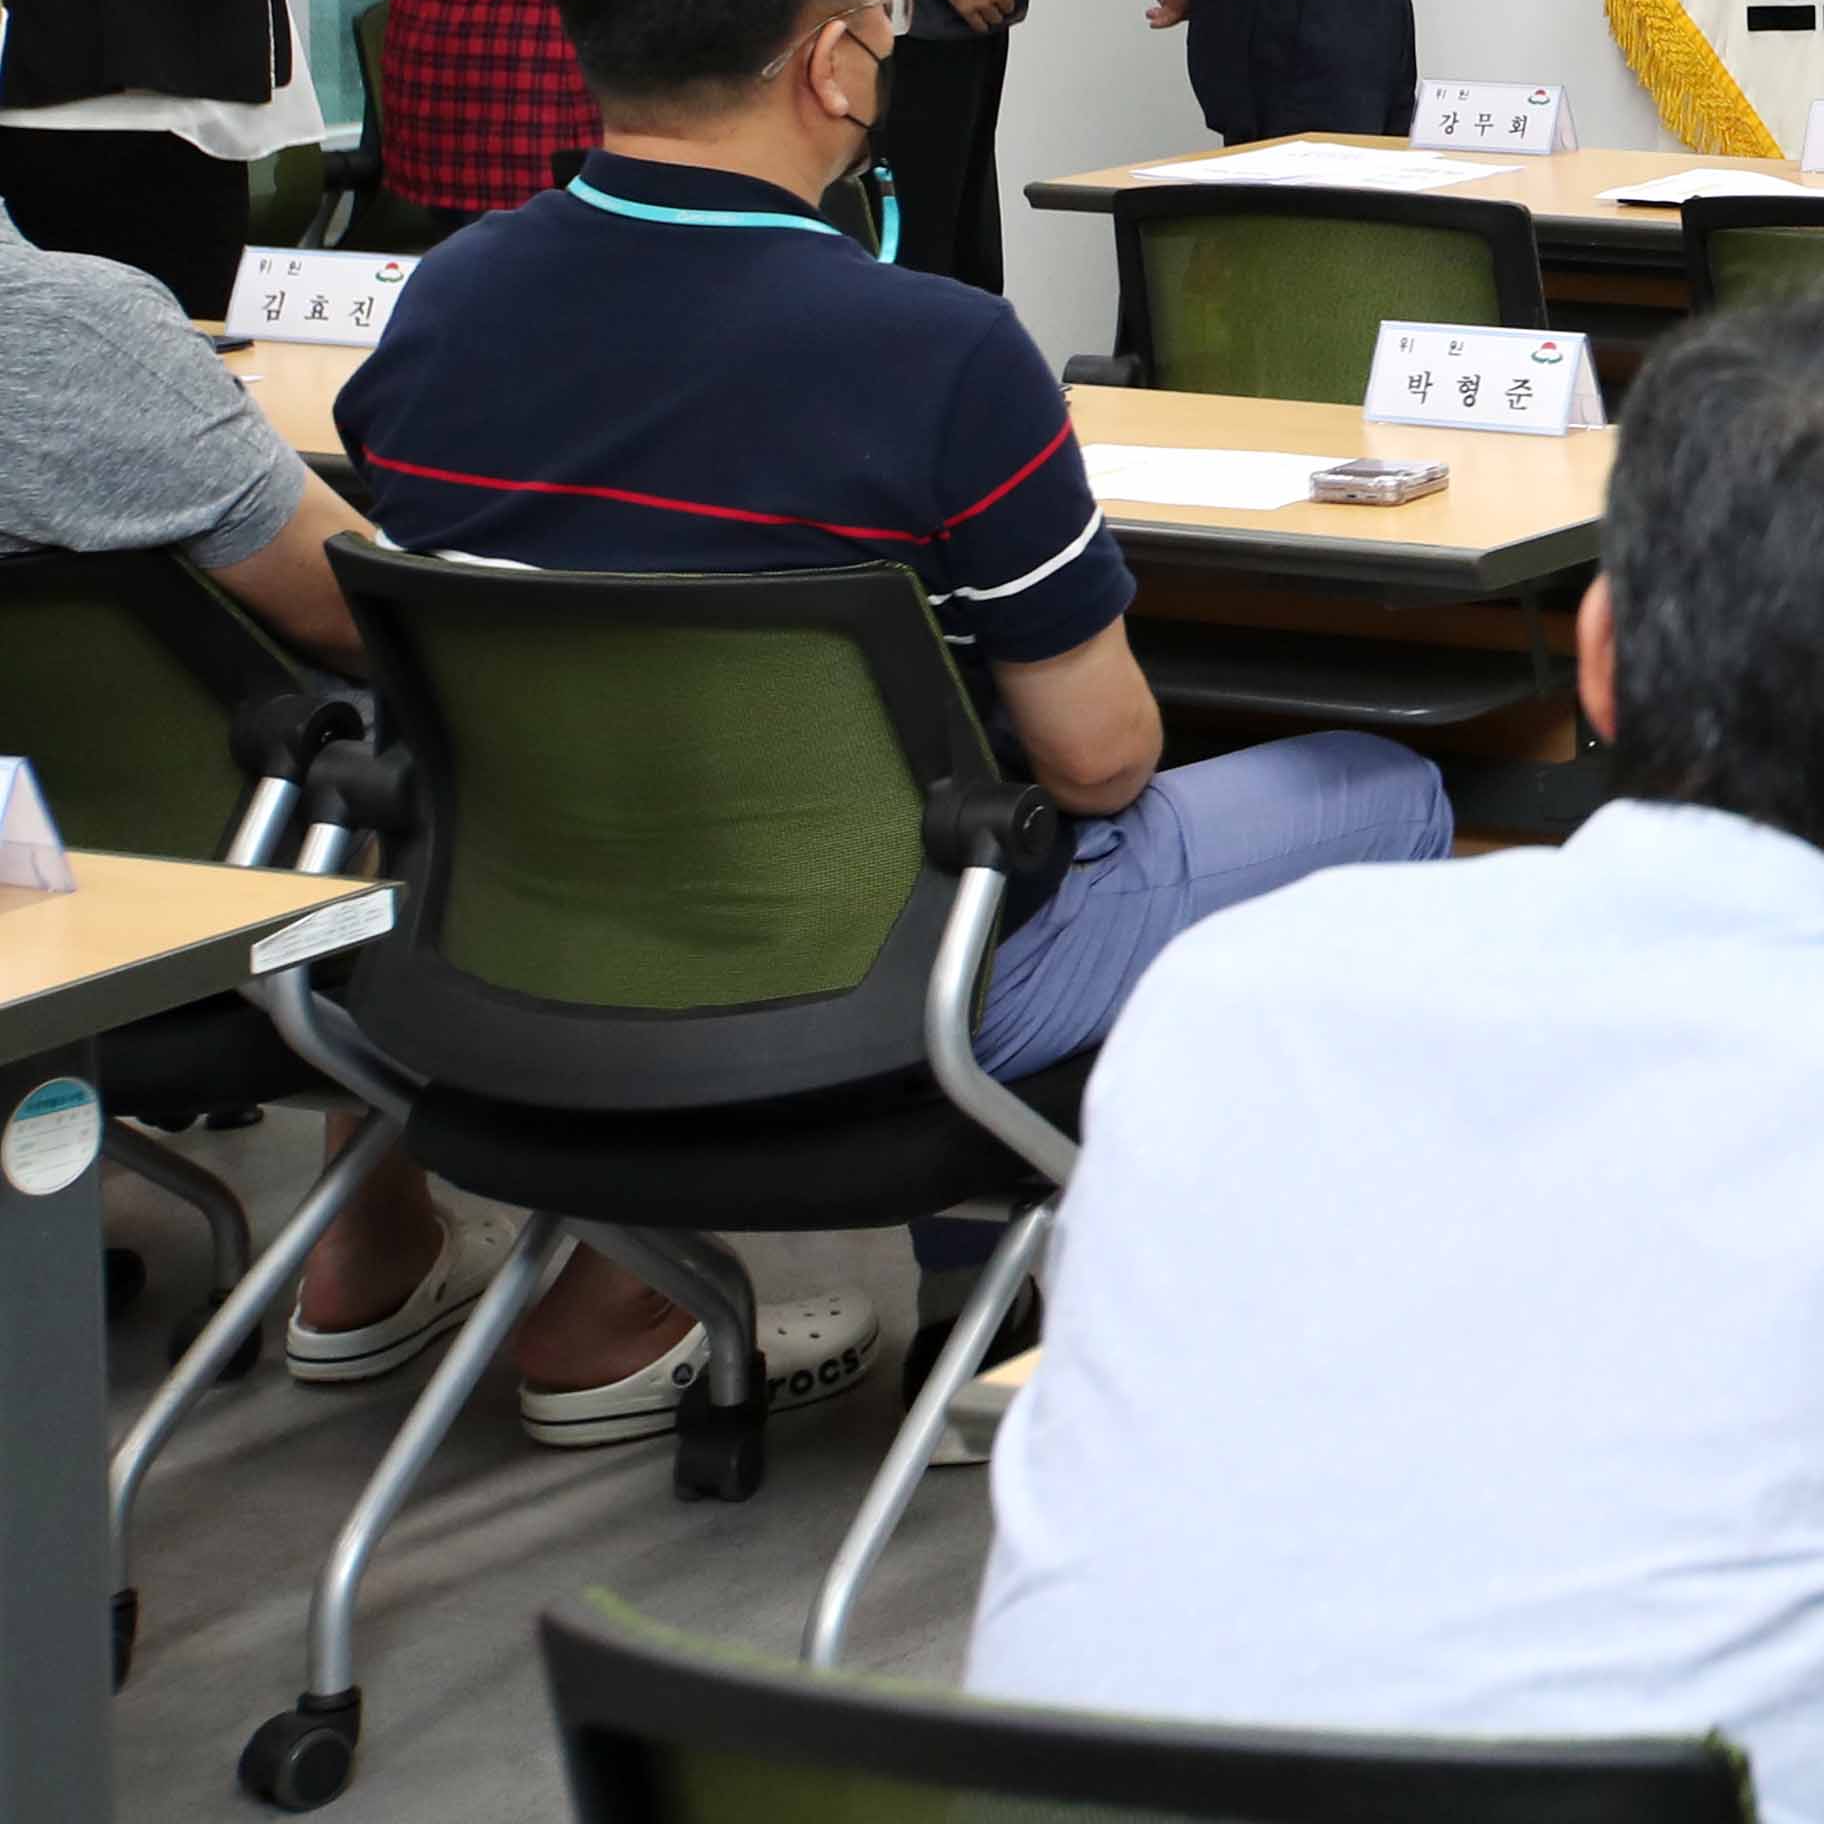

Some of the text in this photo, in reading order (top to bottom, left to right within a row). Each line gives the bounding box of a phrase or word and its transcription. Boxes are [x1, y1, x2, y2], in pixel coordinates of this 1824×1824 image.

[1439, 111, 1528, 140] 강무회
[261, 289, 375, 328] 김효진
[1407, 370, 1534, 411] 박형준
[769, 1344, 861, 1398] rocs
